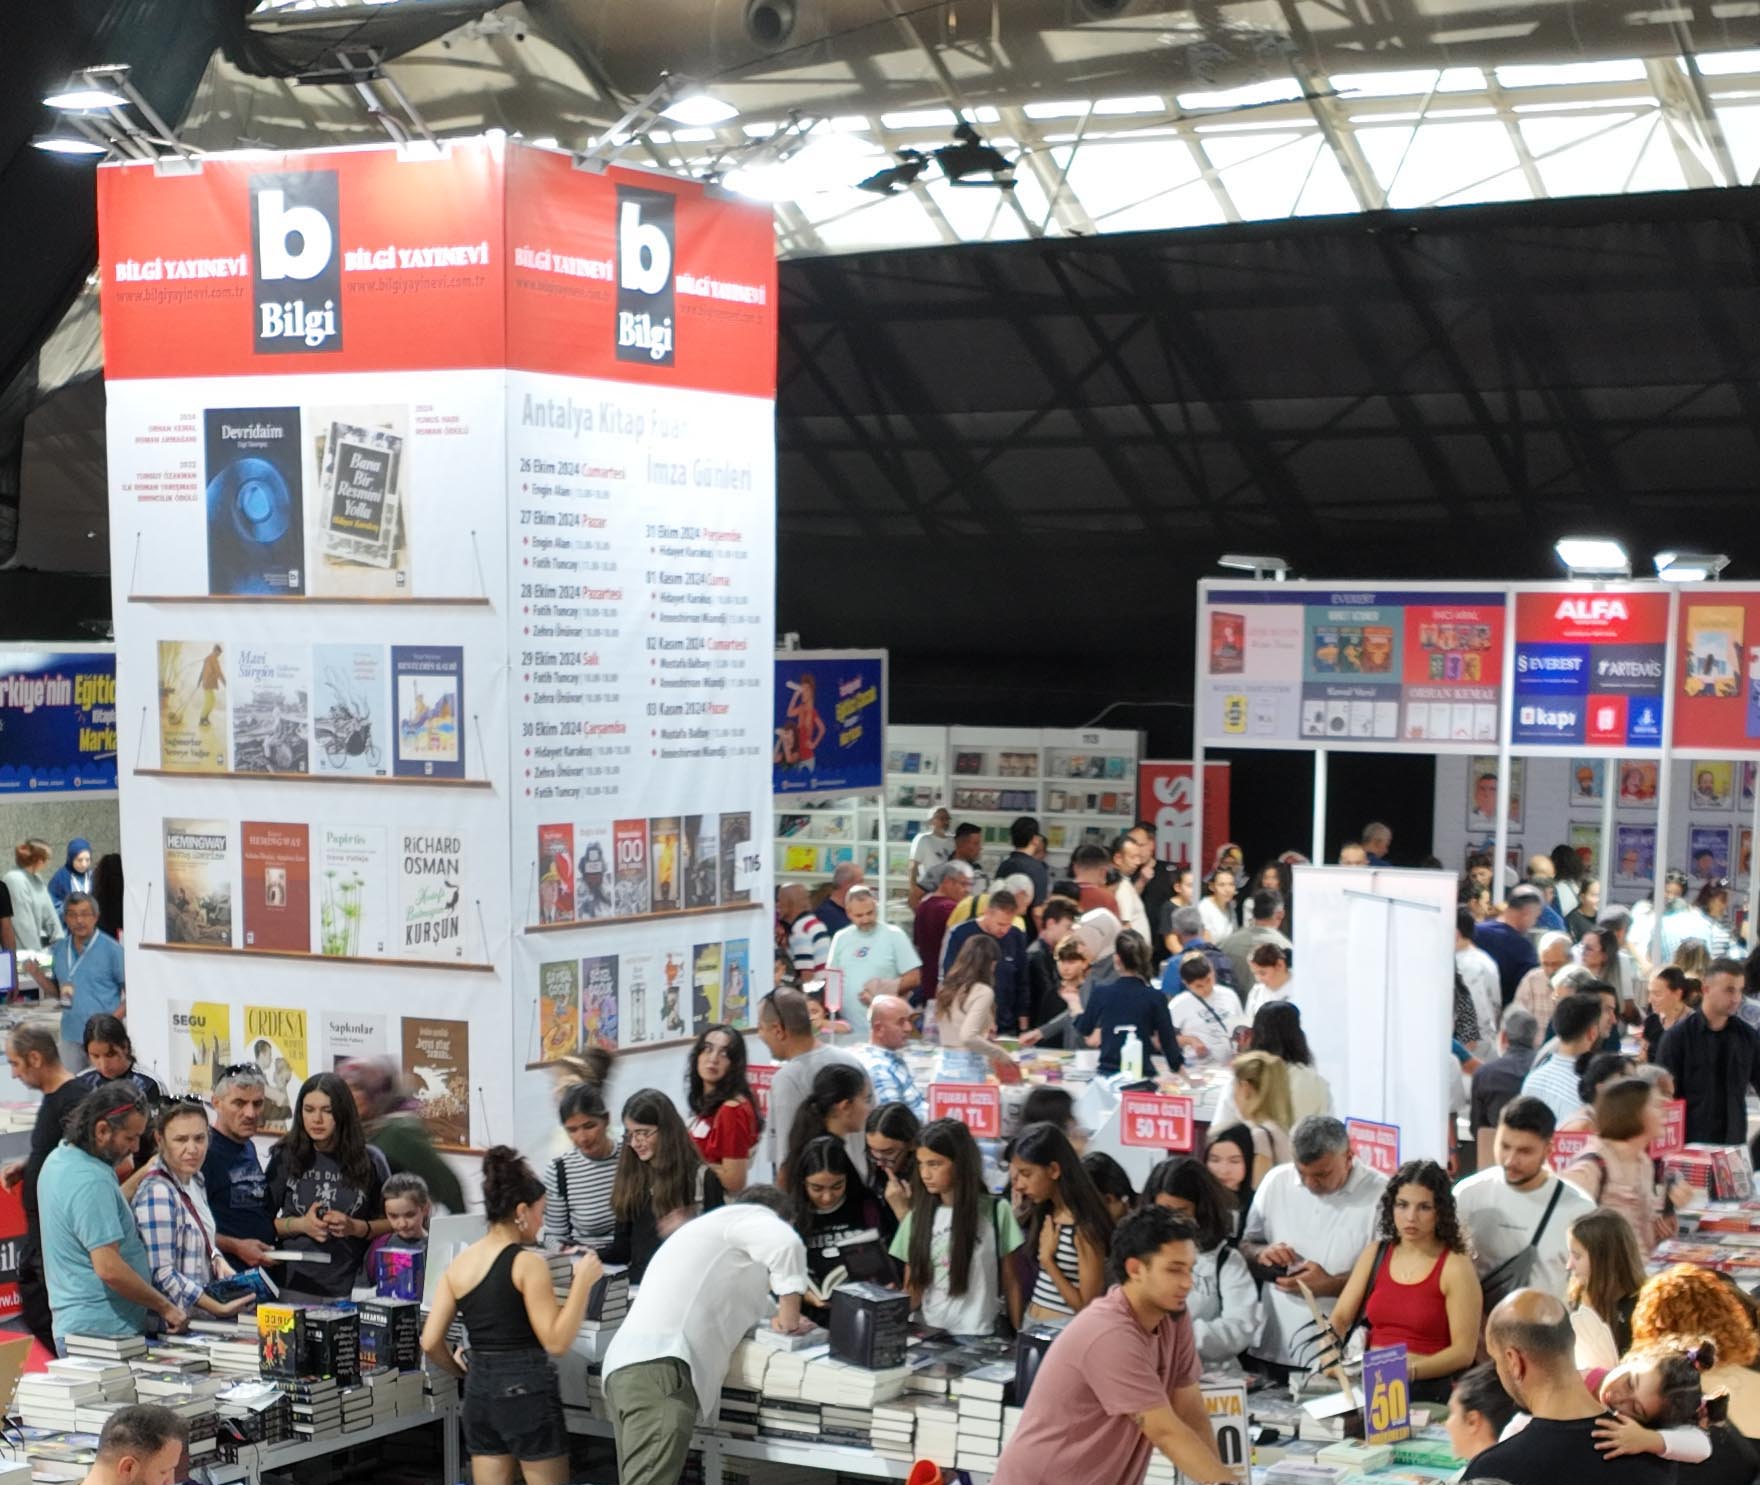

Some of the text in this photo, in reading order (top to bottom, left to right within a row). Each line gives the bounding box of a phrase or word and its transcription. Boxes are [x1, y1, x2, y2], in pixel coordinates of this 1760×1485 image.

[256, 190, 332, 281] b
[345, 241, 489, 272] BİLGİ YAYINEVİ
[621, 201, 671, 295] b
[115, 253, 249, 282] BİLGİ YAYINEVİ
[515, 245, 614, 282] BİLGİ YAYINEVİ
[676, 272, 710, 298] BİLGİ
[260, 300, 337, 347] Bilgi
[618, 311, 673, 360] Bilgi
[522, 393, 593, 438] Antalya
[533, 459, 555, 474] Ekim
[557, 461, 580, 475] 2024
[533, 511, 555, 526] Ekim
[558, 512, 580, 527] 2024
[534, 584, 556, 600] Ekim
[559, 585, 581, 600] 2024
[1554, 599, 1628, 621] ALFA
[535, 652, 557, 666] Ekim
[560, 652, 581, 665] 2024
[1529, 656, 1583, 672] EVEREST
[535, 722, 558, 737] Ekim
[560, 722, 582, 736] 2024
[167, 835, 227, 850] HEMINGWAY
[616, 839, 643, 863] 100
[404, 857, 459, 875] OSMAN
[405, 917, 460, 948] KURŞUN
[172, 1014, 207, 1027] SEGU
[248, 1008, 305, 1039] ORDESA
[968, 1109, 988, 1129] TL
[1135, 1119, 1178, 1141] 50 TL
